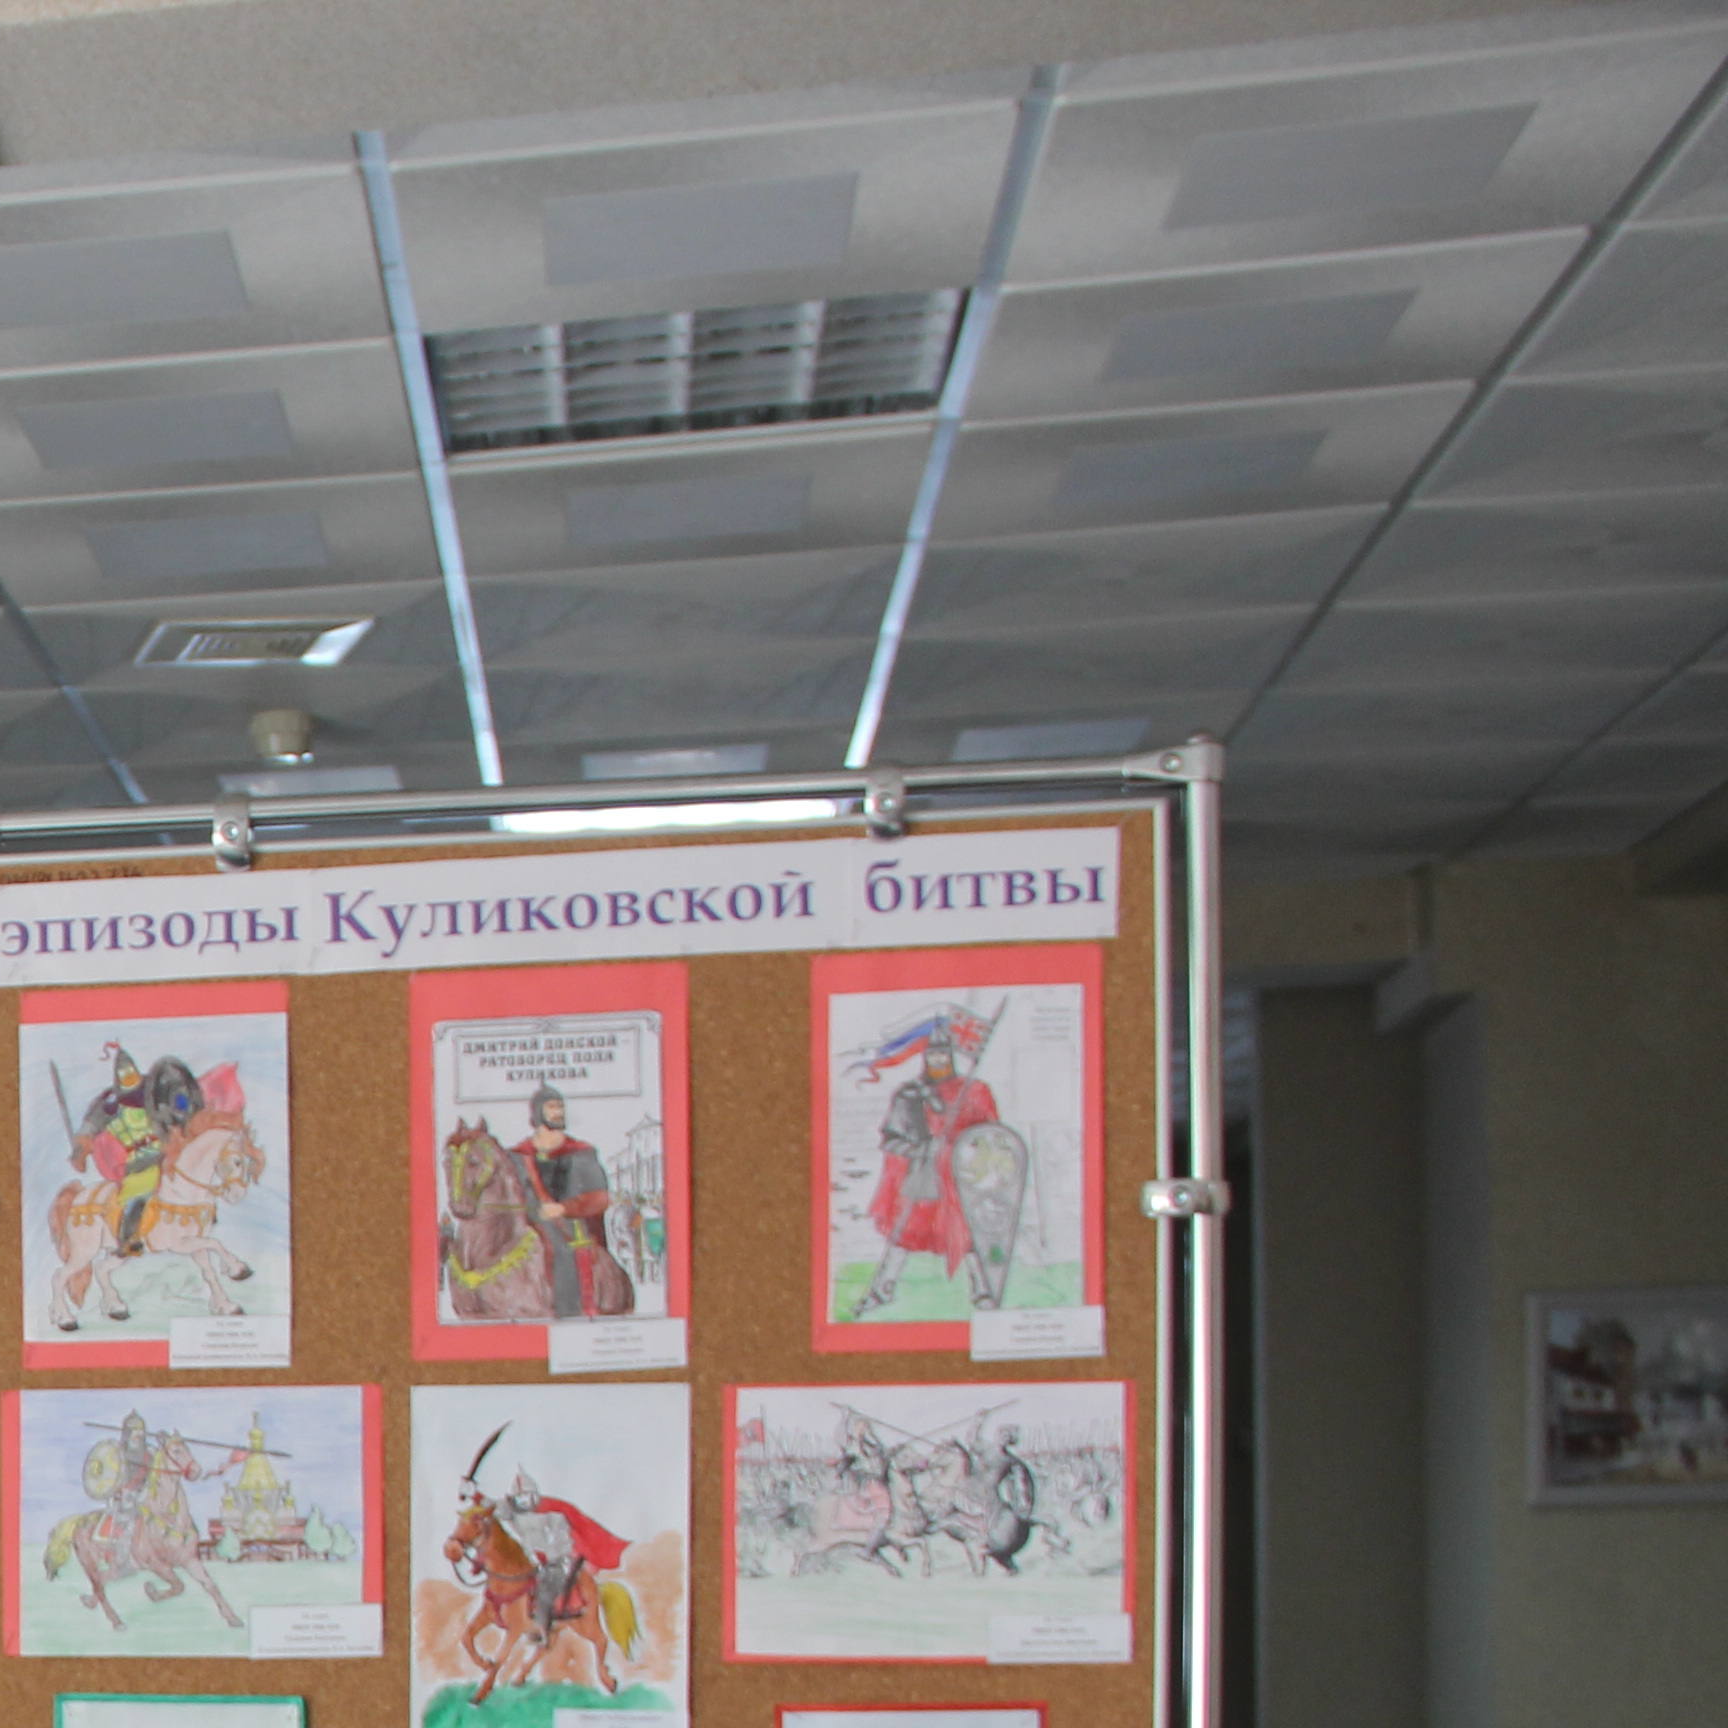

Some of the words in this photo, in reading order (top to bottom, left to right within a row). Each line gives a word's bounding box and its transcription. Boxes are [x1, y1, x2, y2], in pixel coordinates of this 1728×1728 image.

[0, 905, 298, 956] эпизоды
[324, 868, 814, 958] Куликовской
[864, 859, 1105, 915] битвы
[462, 1036, 540, 1055] ДМИТРИЙ
[544, 1034, 618, 1051] ДОНСКОЙ
[572, 1049, 614, 1064] ПОЛЯ
[505, 1067, 588, 1082] КУЛИКОВА
